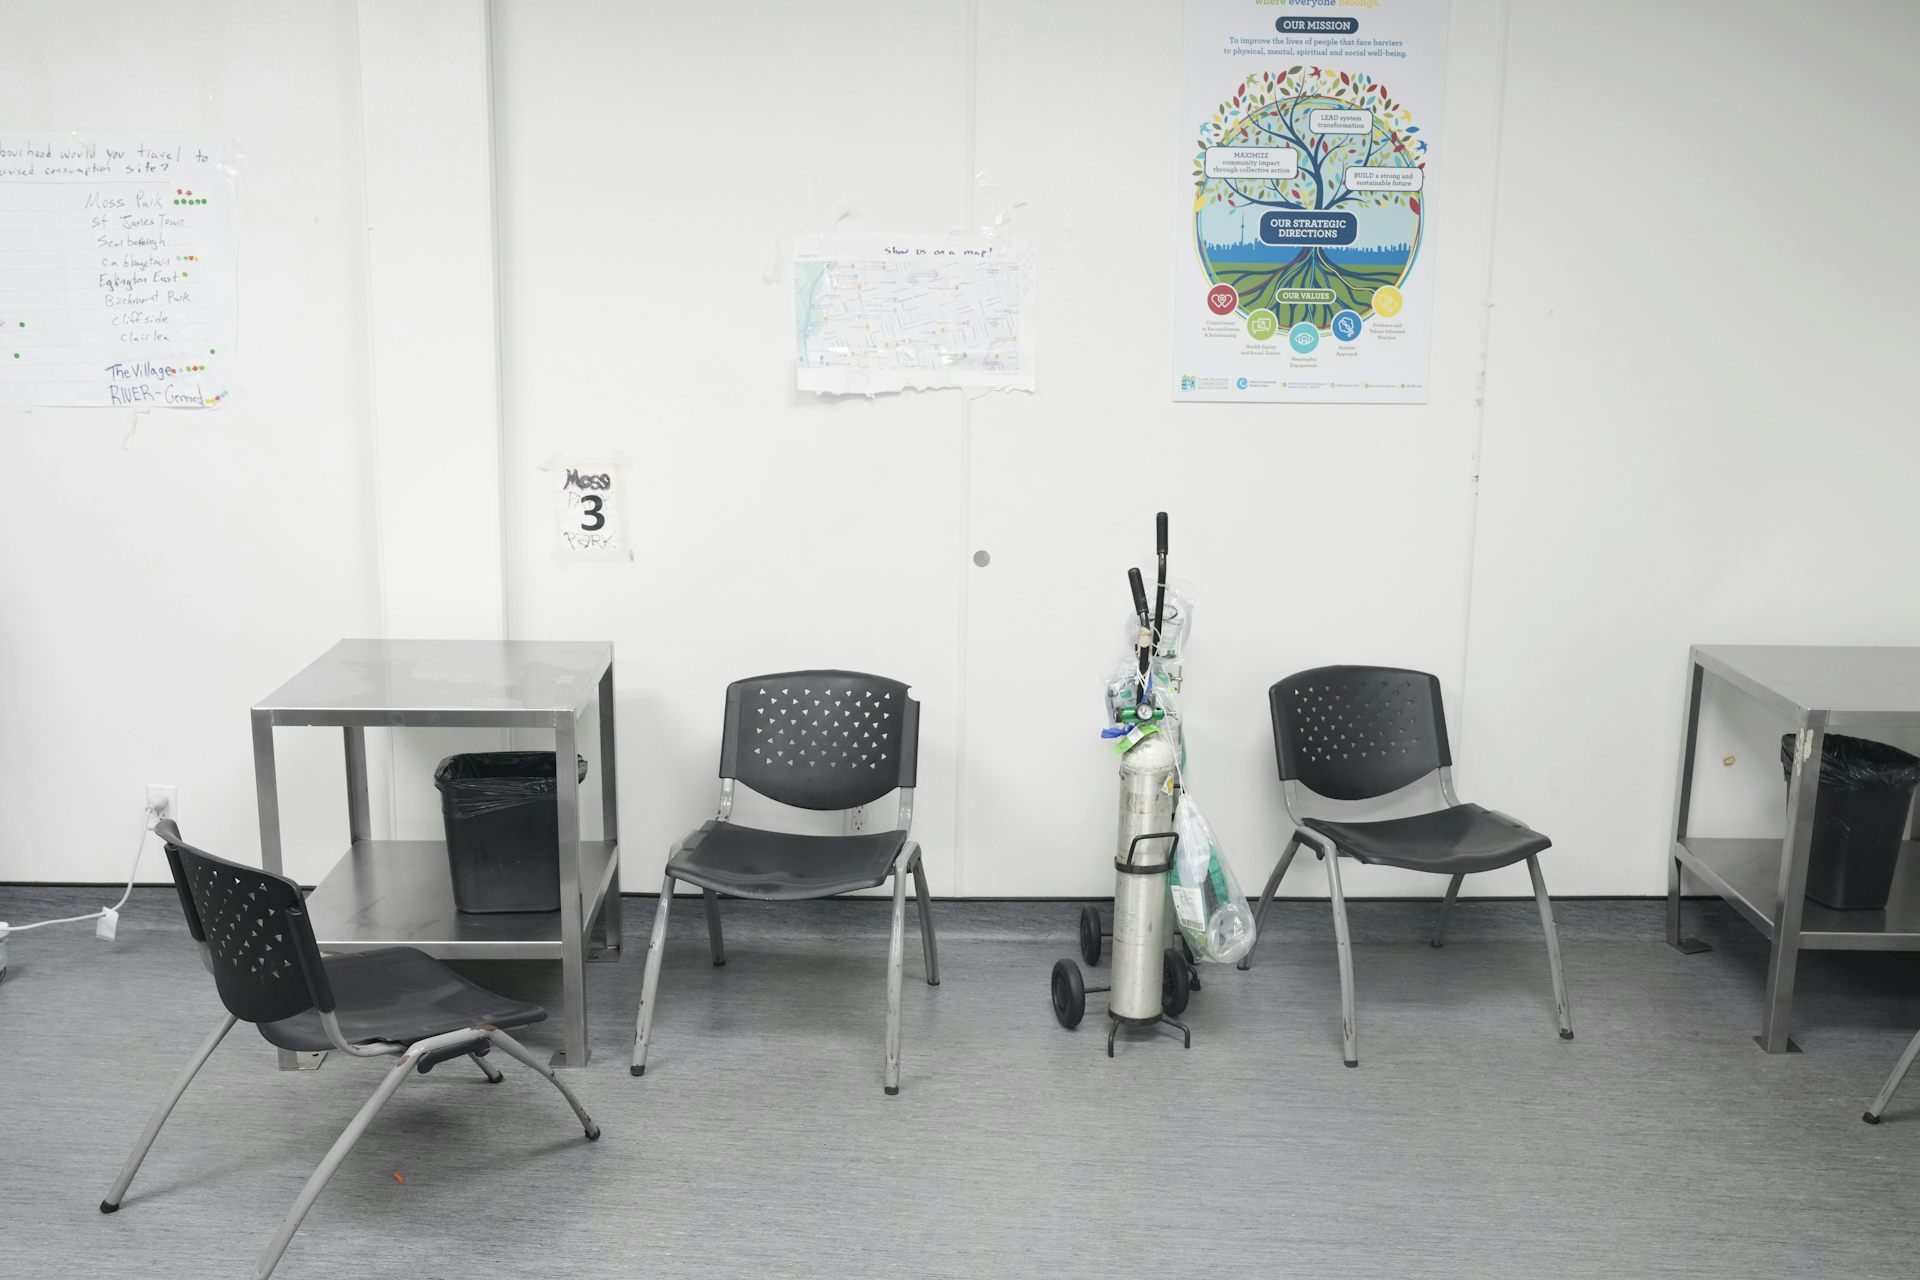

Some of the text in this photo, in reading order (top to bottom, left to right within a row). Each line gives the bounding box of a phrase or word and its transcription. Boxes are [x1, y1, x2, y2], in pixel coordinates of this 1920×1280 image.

[1288, 0, 1336, 8] everyone
[1283, 20, 1351, 31] OUR MISSION
[1229, 36, 1403, 47] To improve the lives of people that face barriers
[1223, 47, 1232, 55] to
[1233, 45, 1266, 56] physical,
[1267, 47, 1295, 56] mental,
[1296, 48, 1328, 57] spiritual
[1344, 49, 1366, 57] social
[1367, 49, 1408, 58] well-being.
[60, 144, 97, 160] would
[105, 148, 125, 166] you
[137, 143, 182, 163] travel
[195, 149, 209, 163] to
[1222, 159, 1257, 167] community
[44, 162, 112, 177] consumption
[125, 161, 170, 176] site?
[1213, 166, 1238, 174] through
[1380, 172, 1400, 180] strong
[85, 188, 164, 209] Moss Park
[1270, 218, 1347, 230] OUR STRATEGIC
[1278, 229, 1338, 240] DIRECTIONS
[884, 246, 910, 256] Show
[934, 248, 946, 256] on
[153, 270, 180, 284] East
[1282, 291, 1330, 300] OUR VALUES
[131, 361, 172, 381] Village
[563, 468, 611, 491] Moss
[580, 494, 606, 531] 3
